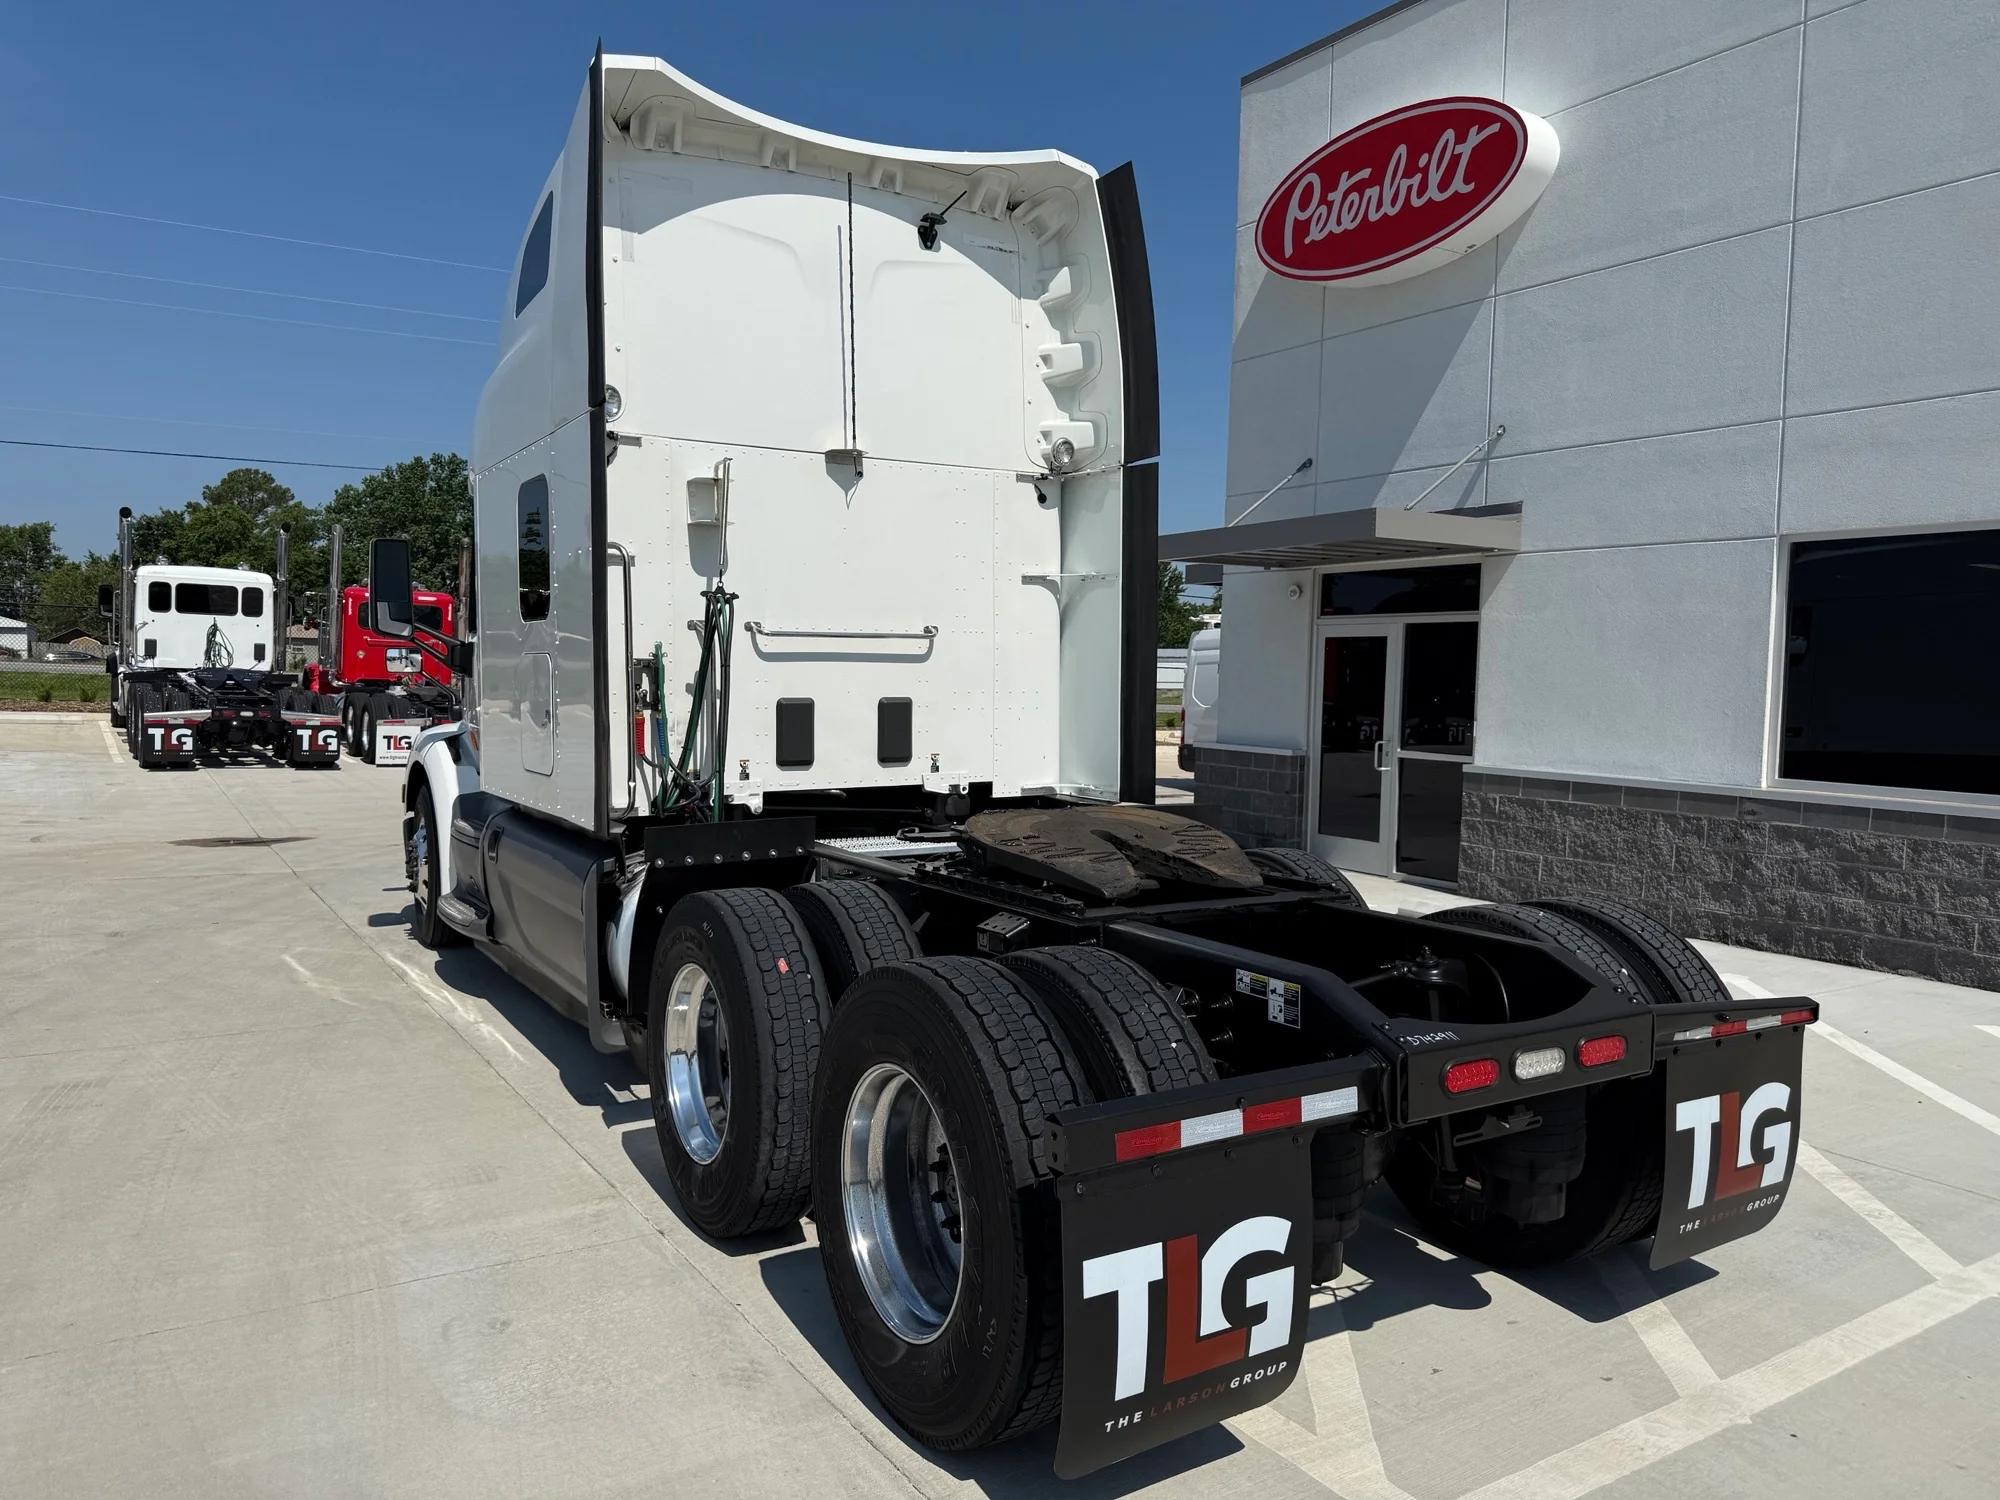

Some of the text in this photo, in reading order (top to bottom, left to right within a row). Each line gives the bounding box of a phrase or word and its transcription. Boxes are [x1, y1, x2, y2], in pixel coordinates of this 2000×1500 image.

[1283, 121, 1502, 259] Peterbilt
[148, 728, 193, 750] TLG
[297, 729, 338, 751] TLG
[383, 735, 413, 751] TLG
[1676, 1082, 1791, 1210] TLG
[1680, 1219, 1701, 1234] THE
[1746, 1194, 1780, 1211] GROUP
[1082, 1215, 1295, 1402] TLG
[1105, 1361, 1288, 1433] THE LARSON GROUP
